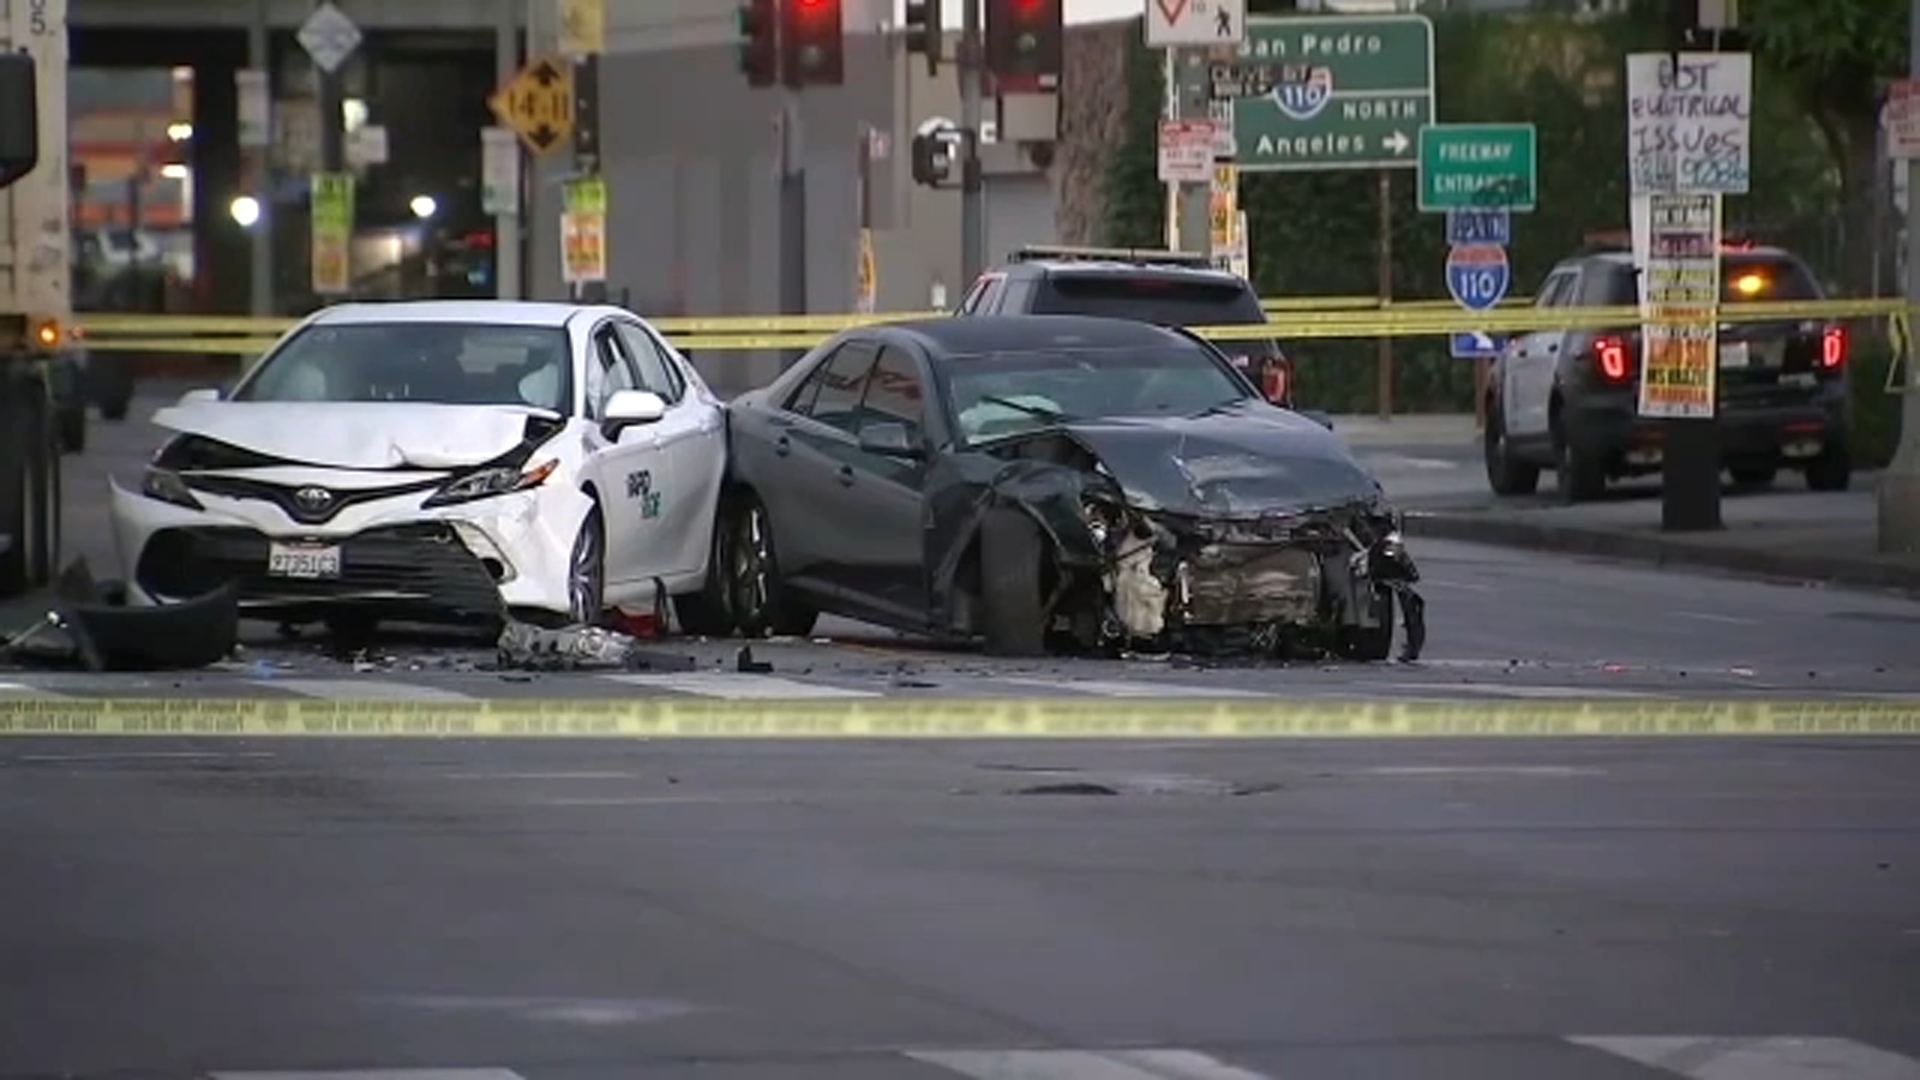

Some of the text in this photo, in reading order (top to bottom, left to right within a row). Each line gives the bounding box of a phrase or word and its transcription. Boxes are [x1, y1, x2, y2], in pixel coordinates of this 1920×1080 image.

[1302, 33, 1381, 54] Pedro
[1284, 84, 1321, 108] 110
[1343, 100, 1418, 120] NORTH
[1257, 131, 1365, 156] Angeles
[1438, 142, 1513, 163] FREEWAY
[1459, 271, 1496, 299] 110
